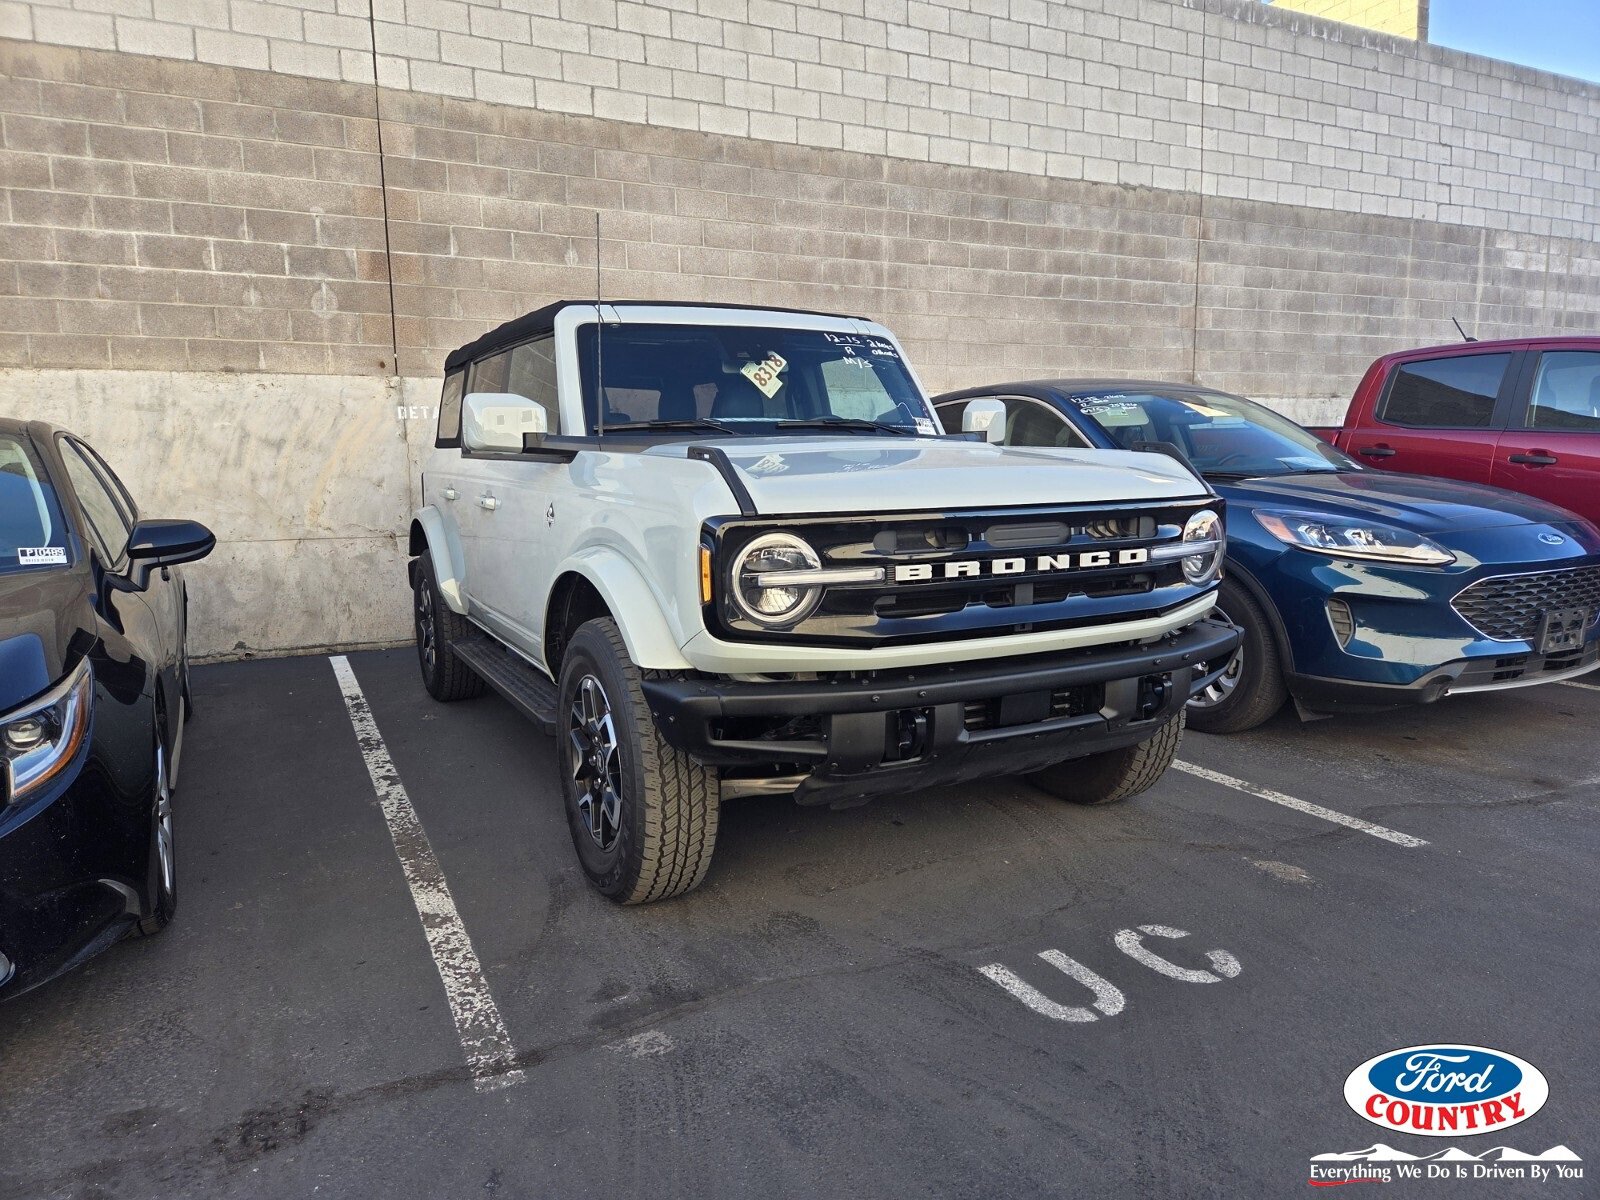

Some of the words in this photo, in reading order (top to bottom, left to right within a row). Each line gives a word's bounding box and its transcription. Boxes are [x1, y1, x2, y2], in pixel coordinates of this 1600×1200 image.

[823, 332, 861, 344] 12-15
[844, 346, 856, 356] R
[753, 354, 783, 387] 8318
[894, 547, 1149, 583] BRONCO
[977, 924, 1242, 1023] UC
